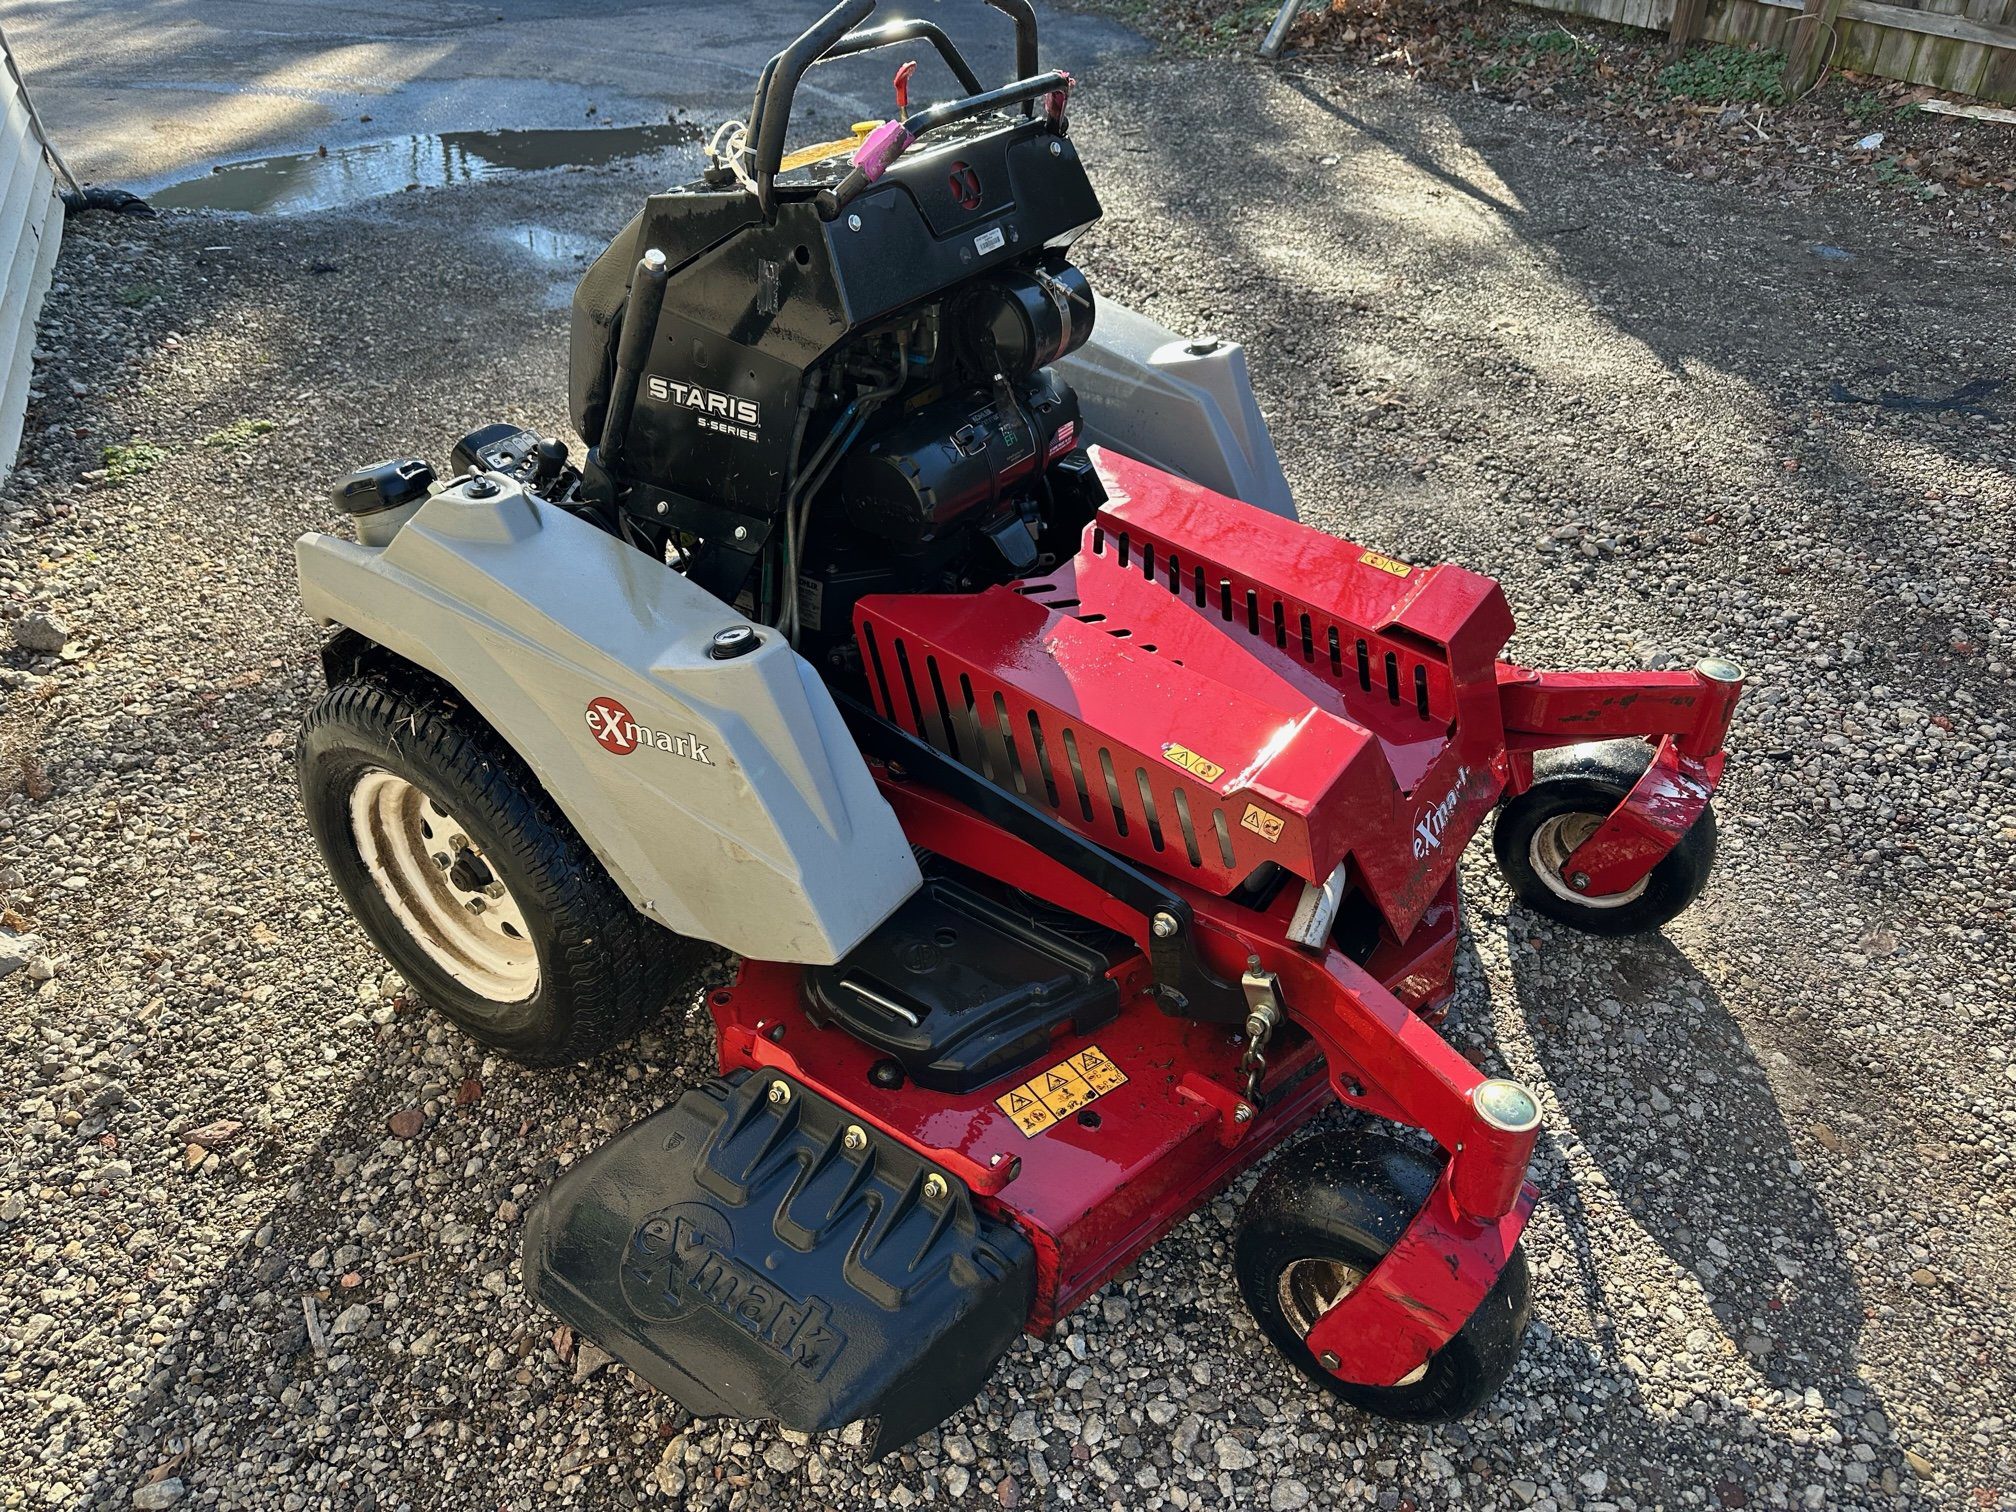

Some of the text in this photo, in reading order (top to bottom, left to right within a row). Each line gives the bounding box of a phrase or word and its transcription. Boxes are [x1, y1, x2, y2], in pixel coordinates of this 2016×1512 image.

[649, 377, 758, 424] STARIS
[698, 418, 758, 441] S-SERIES
[1003, 431, 1018, 447] EFI
[799, 580, 818, 590] OHLER
[585, 704, 711, 765] eXmark
